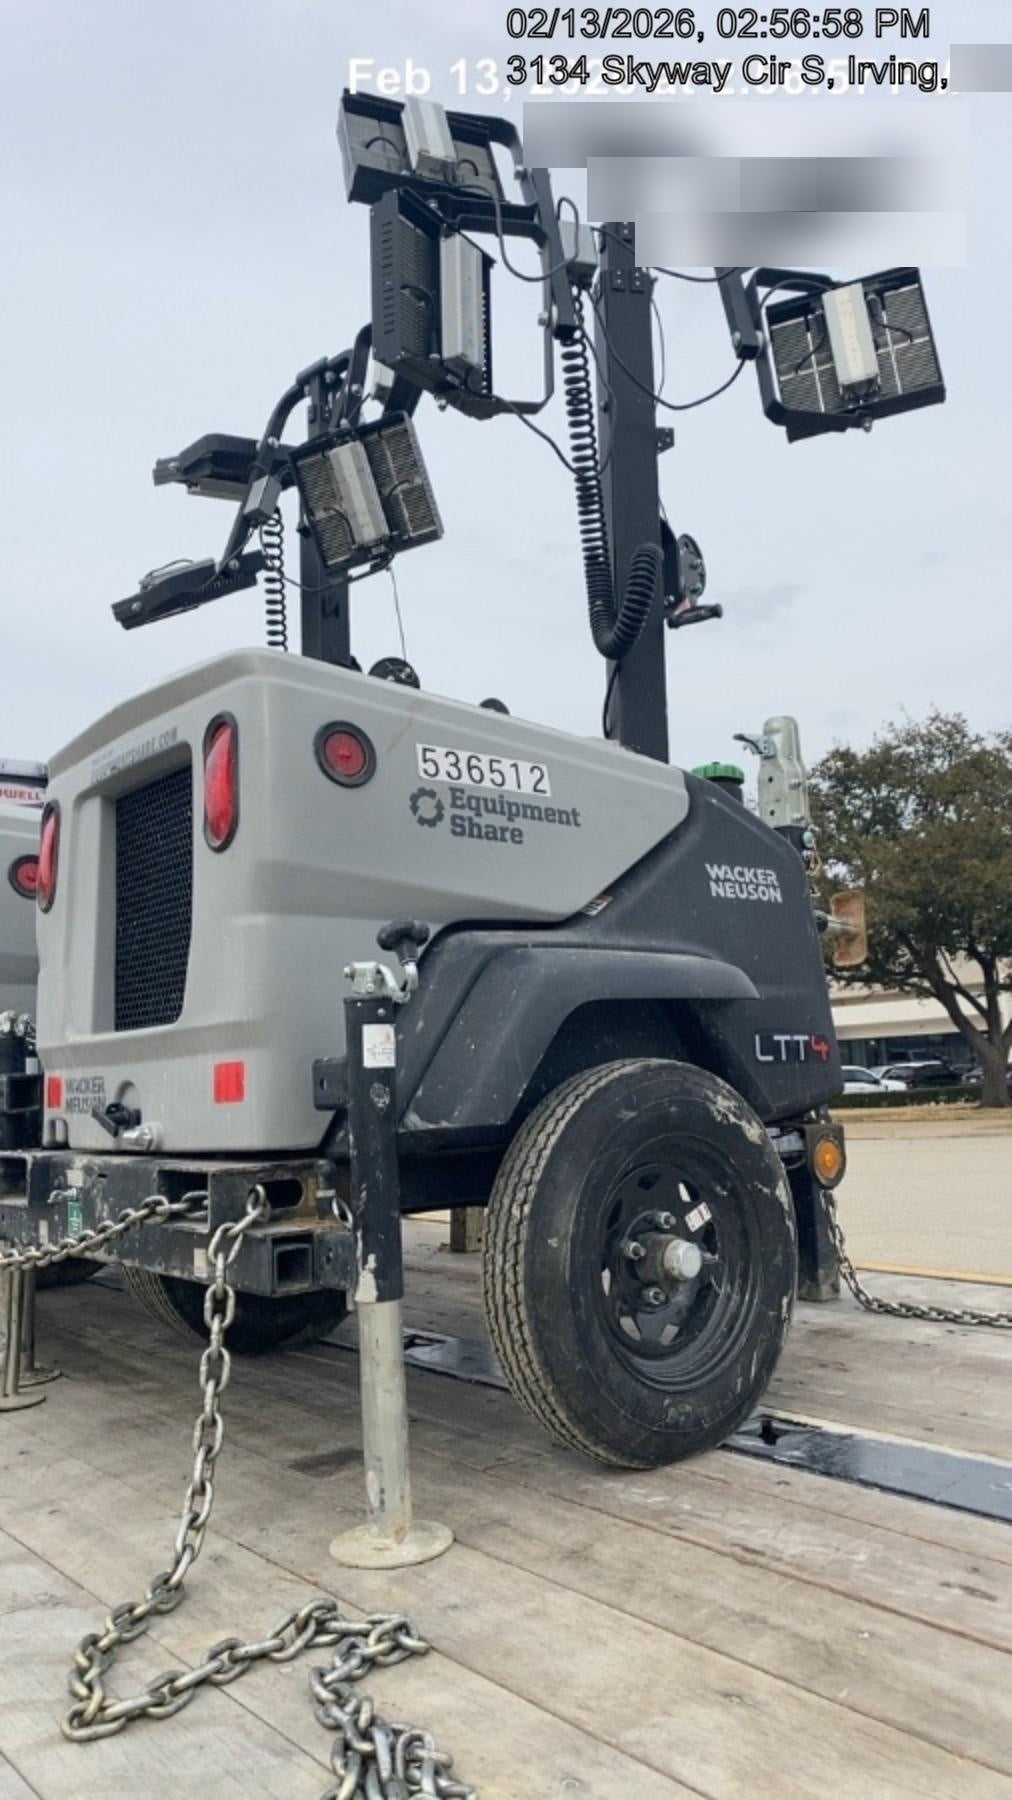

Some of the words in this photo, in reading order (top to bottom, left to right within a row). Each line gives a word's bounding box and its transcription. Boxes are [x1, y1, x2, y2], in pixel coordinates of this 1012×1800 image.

[421, 747, 547, 794] 536512
[449, 787, 581, 827] Equipment
[450, 814, 524, 845] Share
[705, 863, 779, 887] WACKER
[709, 881, 783, 904] NEUSON
[755, 1033, 830, 1061] LTT4
